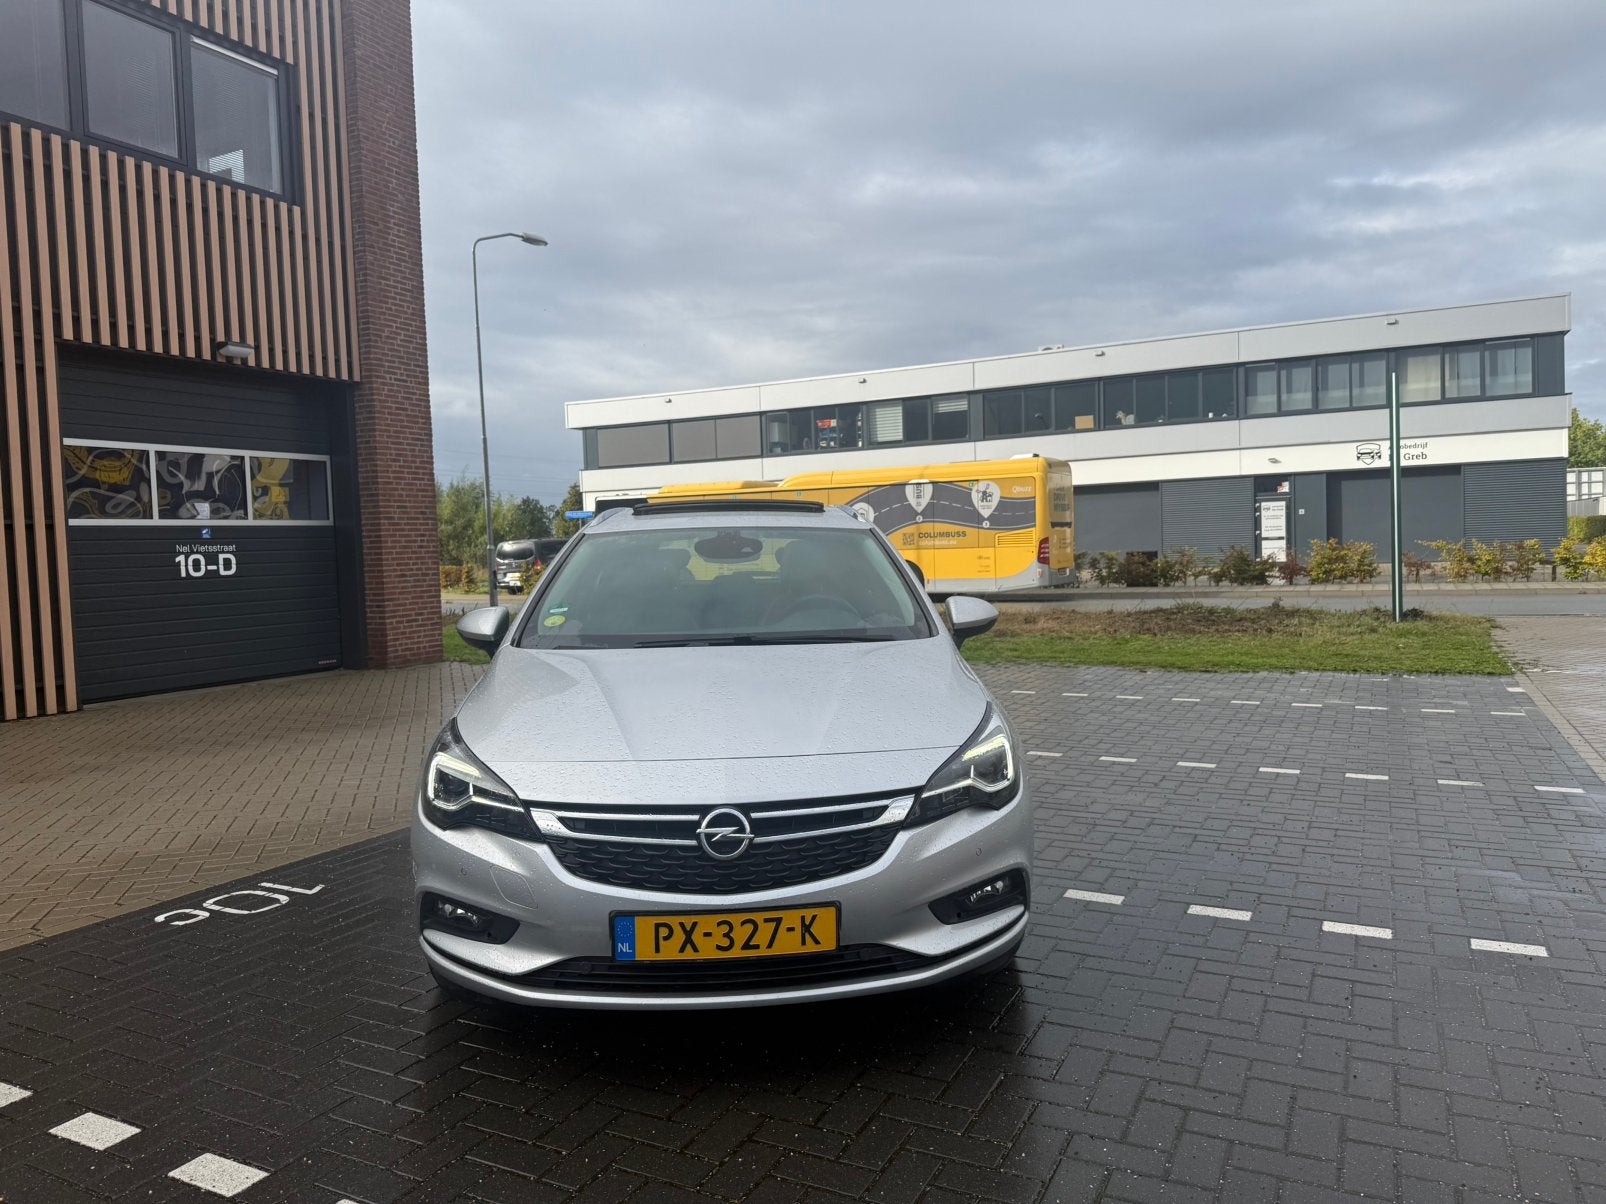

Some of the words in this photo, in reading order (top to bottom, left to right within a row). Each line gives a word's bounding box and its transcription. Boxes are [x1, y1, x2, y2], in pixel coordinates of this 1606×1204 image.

[1388, 441, 1428, 450] obedrijf
[1403, 452, 1428, 461] Greb
[918, 530, 967, 539] COLUMBUSS
[175, 544, 191, 553] Nel
[192, 544, 237, 552] Vietsstraat
[175, 553, 237, 578] 10-D
[653, 913, 822, 954] PX-327-K
[617, 943, 633, 953] NL
